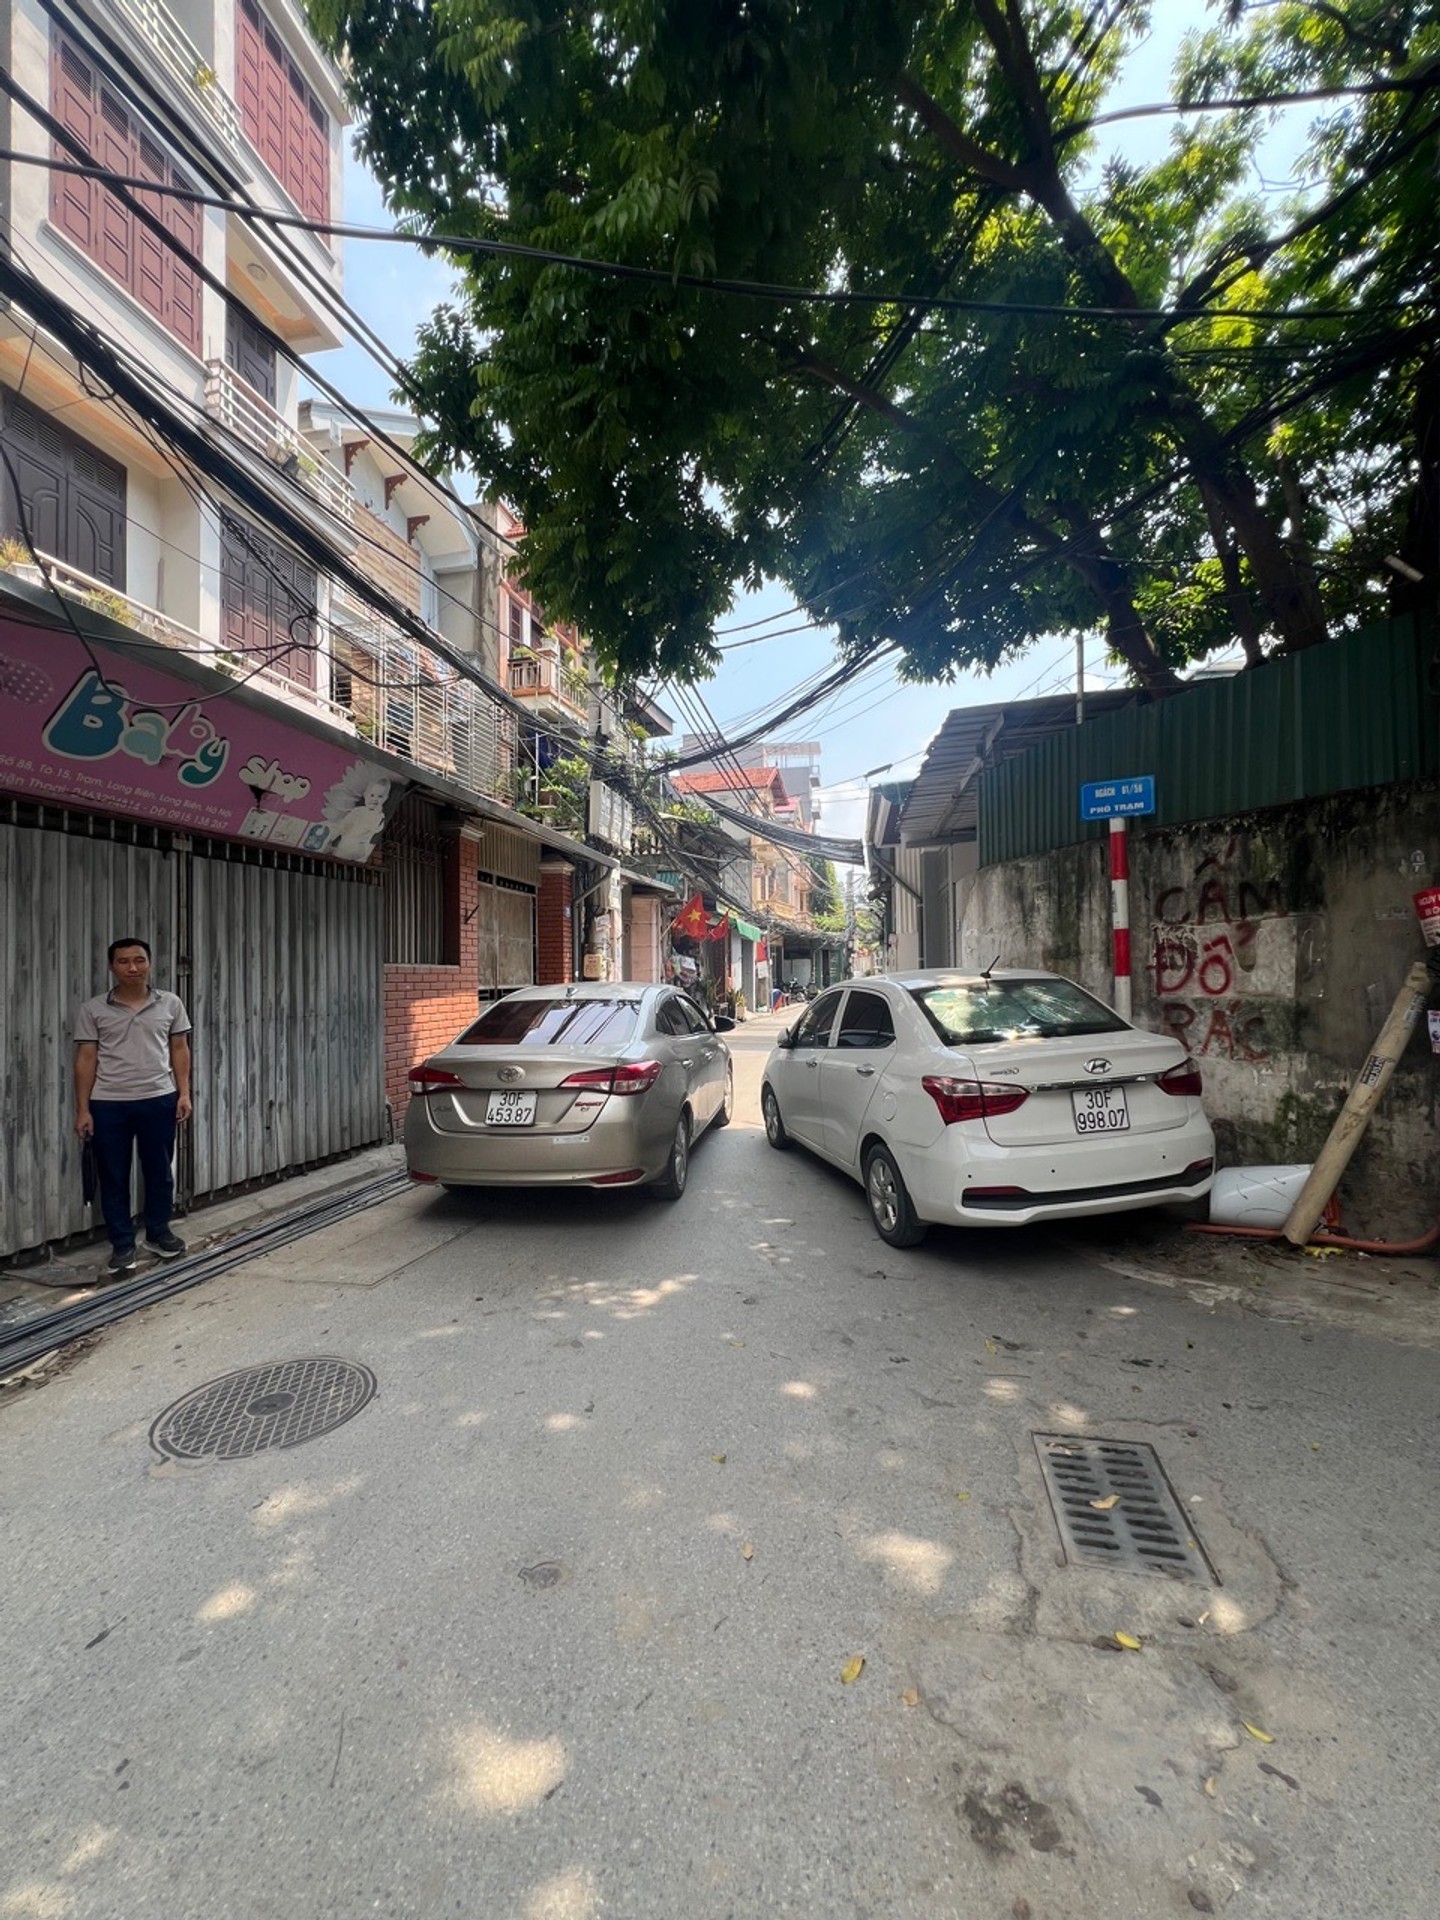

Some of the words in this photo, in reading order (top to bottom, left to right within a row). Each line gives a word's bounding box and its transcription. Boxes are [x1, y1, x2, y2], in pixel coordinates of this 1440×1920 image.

[42, 667, 230, 788] Baby
[107, 780, 132, 795] Long
[499, 1091, 524, 1107] 30F
[1085, 1090, 1111, 1110] 30F
[487, 1107, 532, 1123] 453.87
[1077, 1109, 1125, 1131] 998.07
